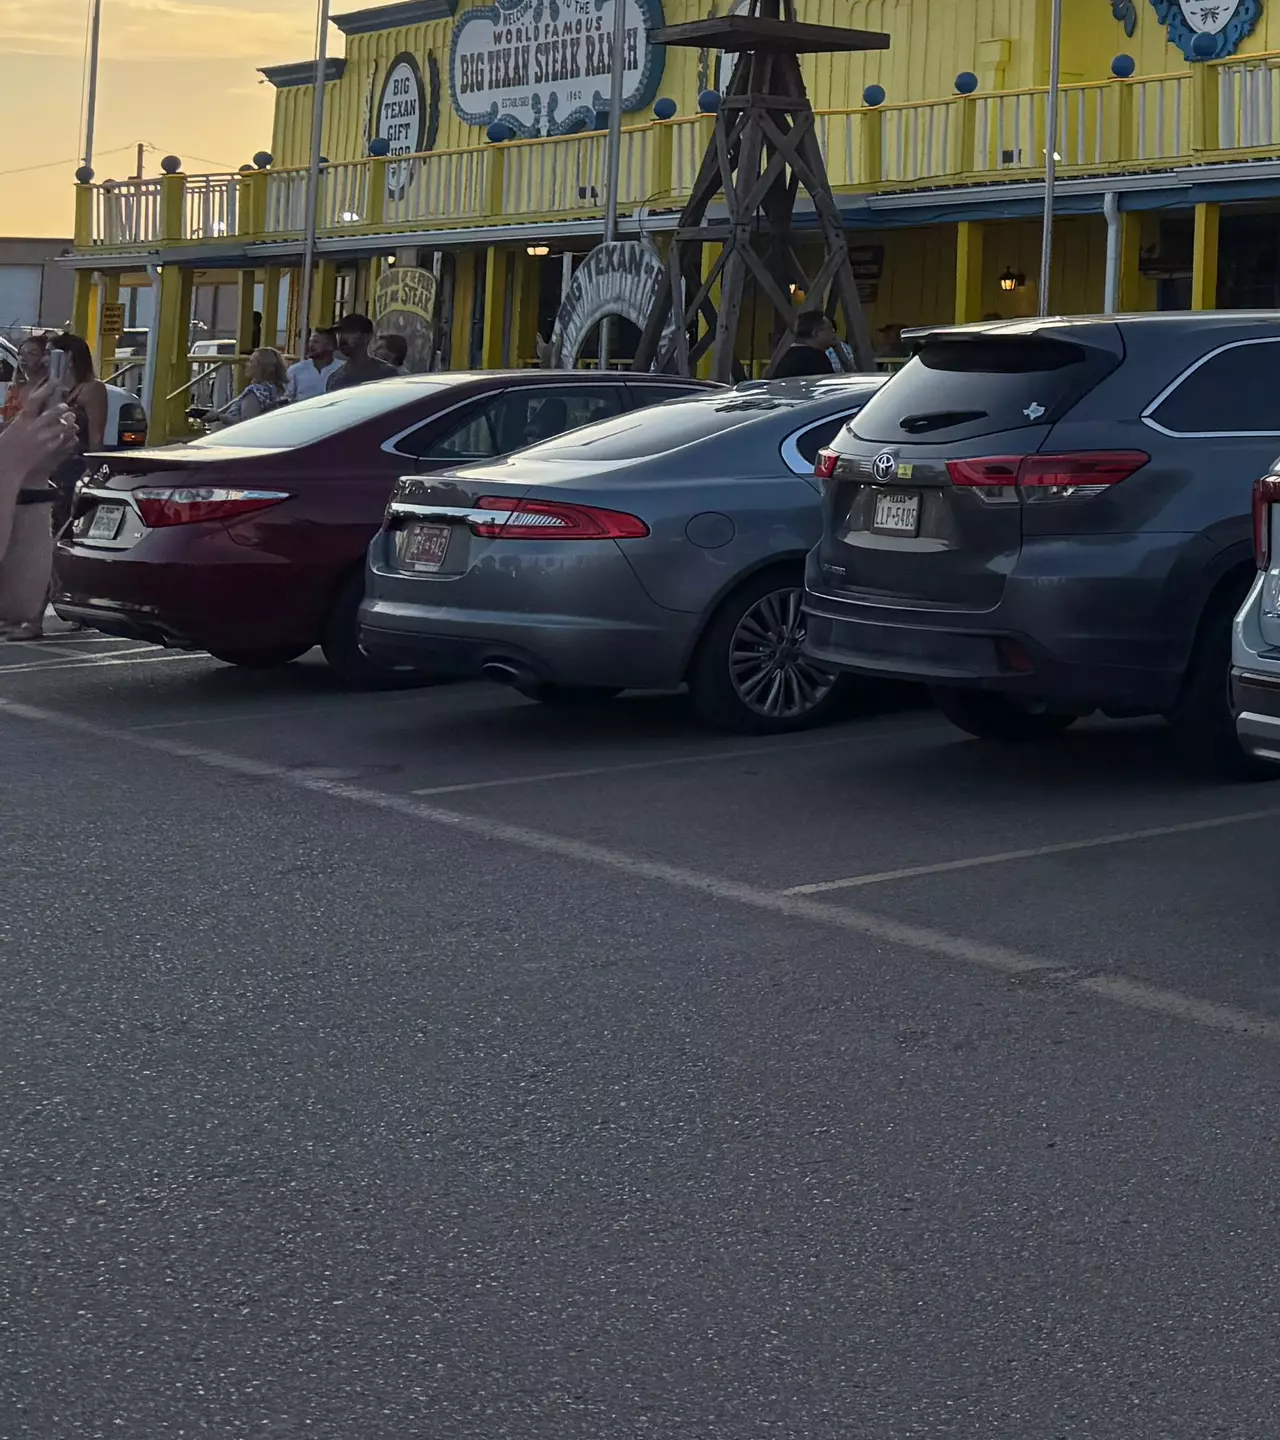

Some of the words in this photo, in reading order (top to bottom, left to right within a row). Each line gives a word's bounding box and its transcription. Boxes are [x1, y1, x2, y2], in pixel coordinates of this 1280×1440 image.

[575, 0, 590, 15] THE
[493, 26, 540, 45] WORLD
[544, 15, 603, 39] FAMOUS
[460, 53, 485, 94] BIG
[487, 45, 530, 90] TEXAN
[534, 36, 581, 84] STEAK
[585, 27, 639, 77] RANH
[393, 77, 410, 96] BIG
[384, 98, 416, 120] TEXAN
[387, 123, 411, 141] GIFT
[582, 242, 645, 283] TEXAN
